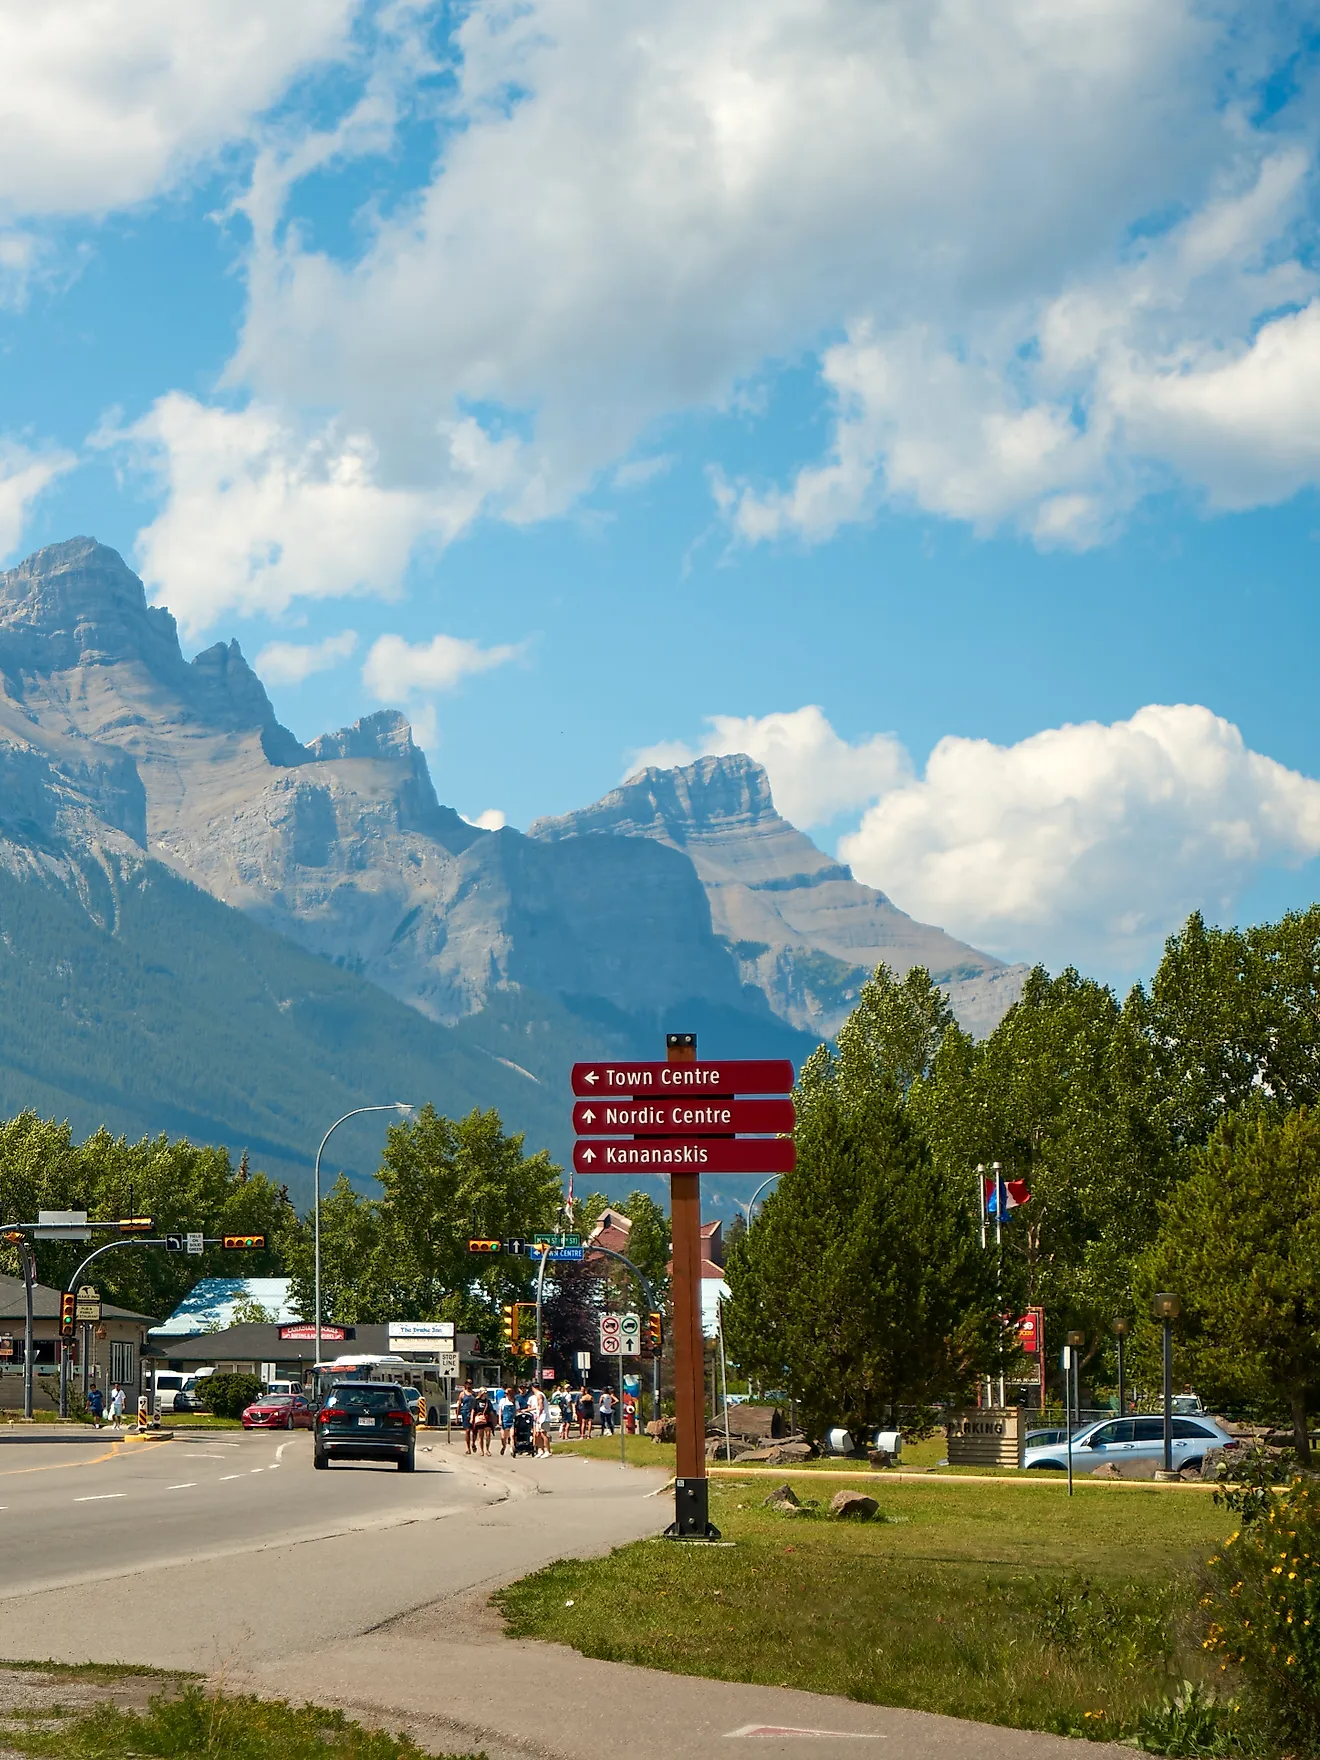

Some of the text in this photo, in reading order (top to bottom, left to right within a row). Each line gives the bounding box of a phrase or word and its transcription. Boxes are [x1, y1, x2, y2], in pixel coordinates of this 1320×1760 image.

[606, 1068, 720, 1086] Town Centre
[606, 1107, 731, 1124] Nordic Centre
[606, 1145, 708, 1164] Kananaskis
[948, 1422, 1002, 1434] PARKING
